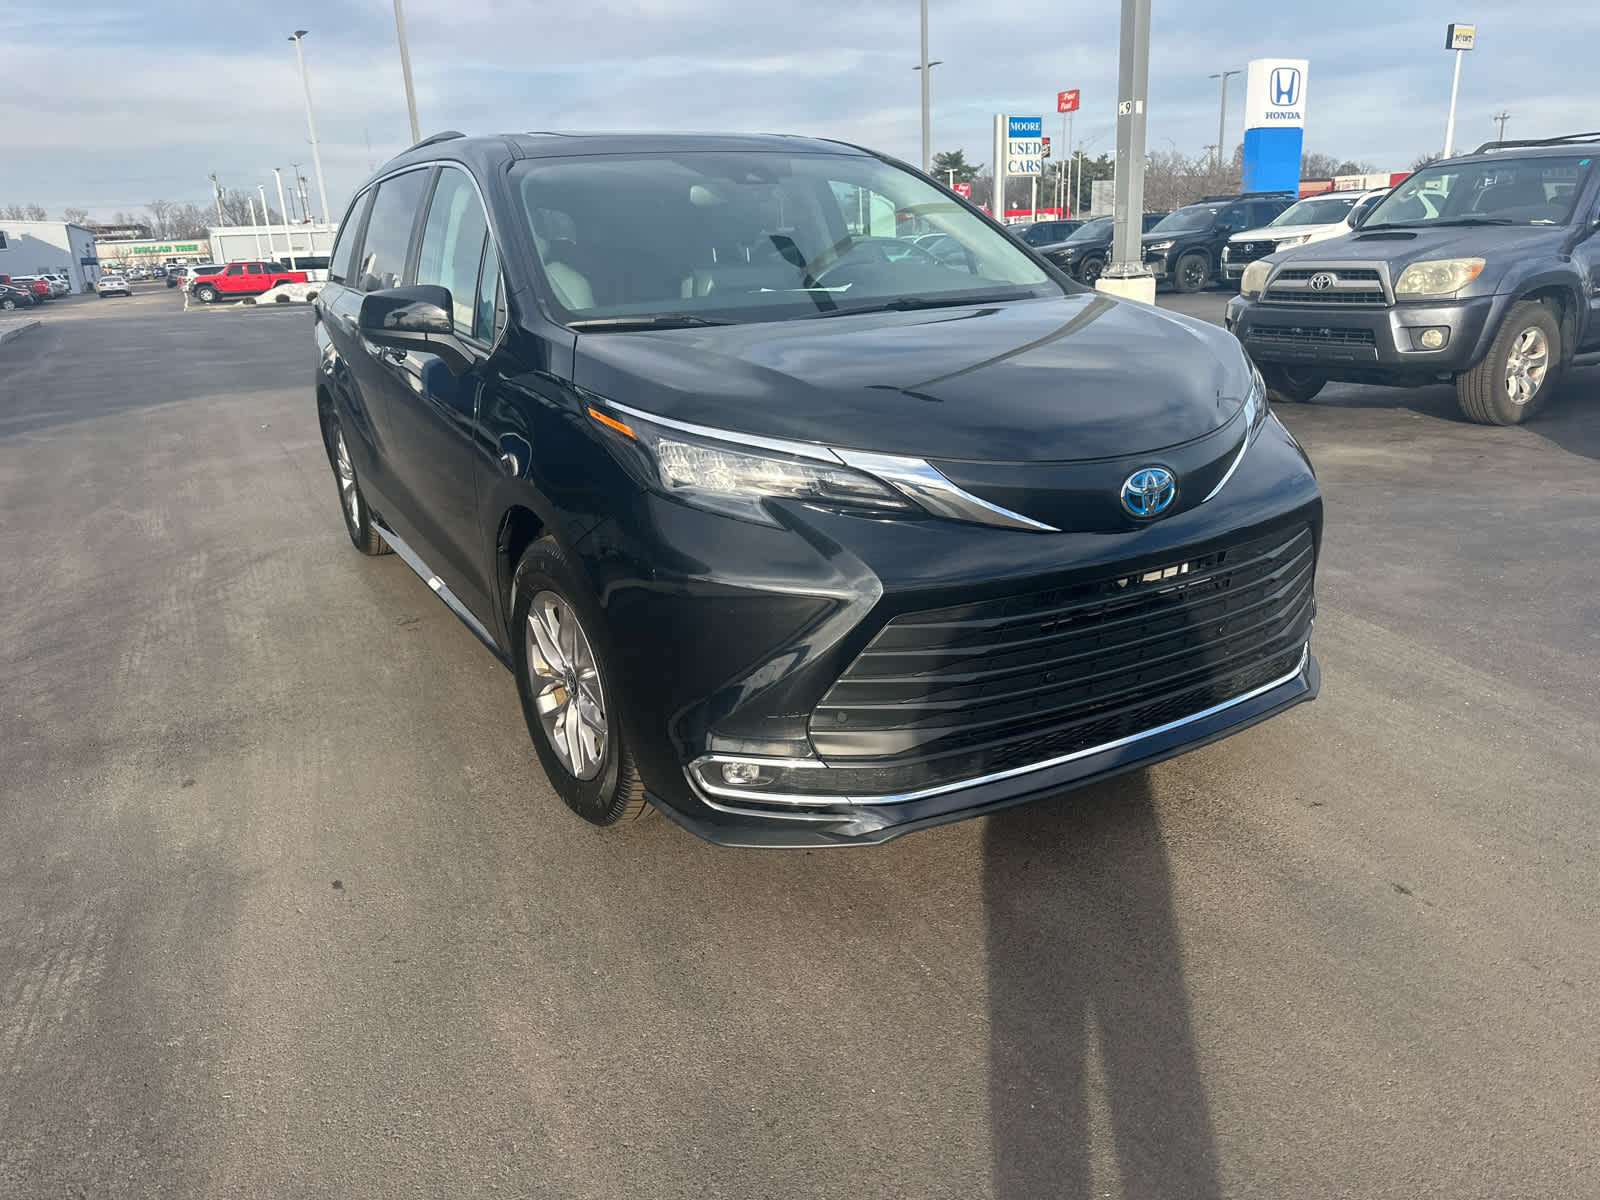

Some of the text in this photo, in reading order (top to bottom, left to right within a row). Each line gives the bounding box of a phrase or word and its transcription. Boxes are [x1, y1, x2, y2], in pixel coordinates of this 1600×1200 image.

[1265, 111, 1301, 120] HONDA
[1010, 121, 1041, 131] MOORE
[1009, 142, 1041, 155] USED
[1008, 160, 1041, 173] CARS
[133, 244, 198, 254] DOLLAR TREE
